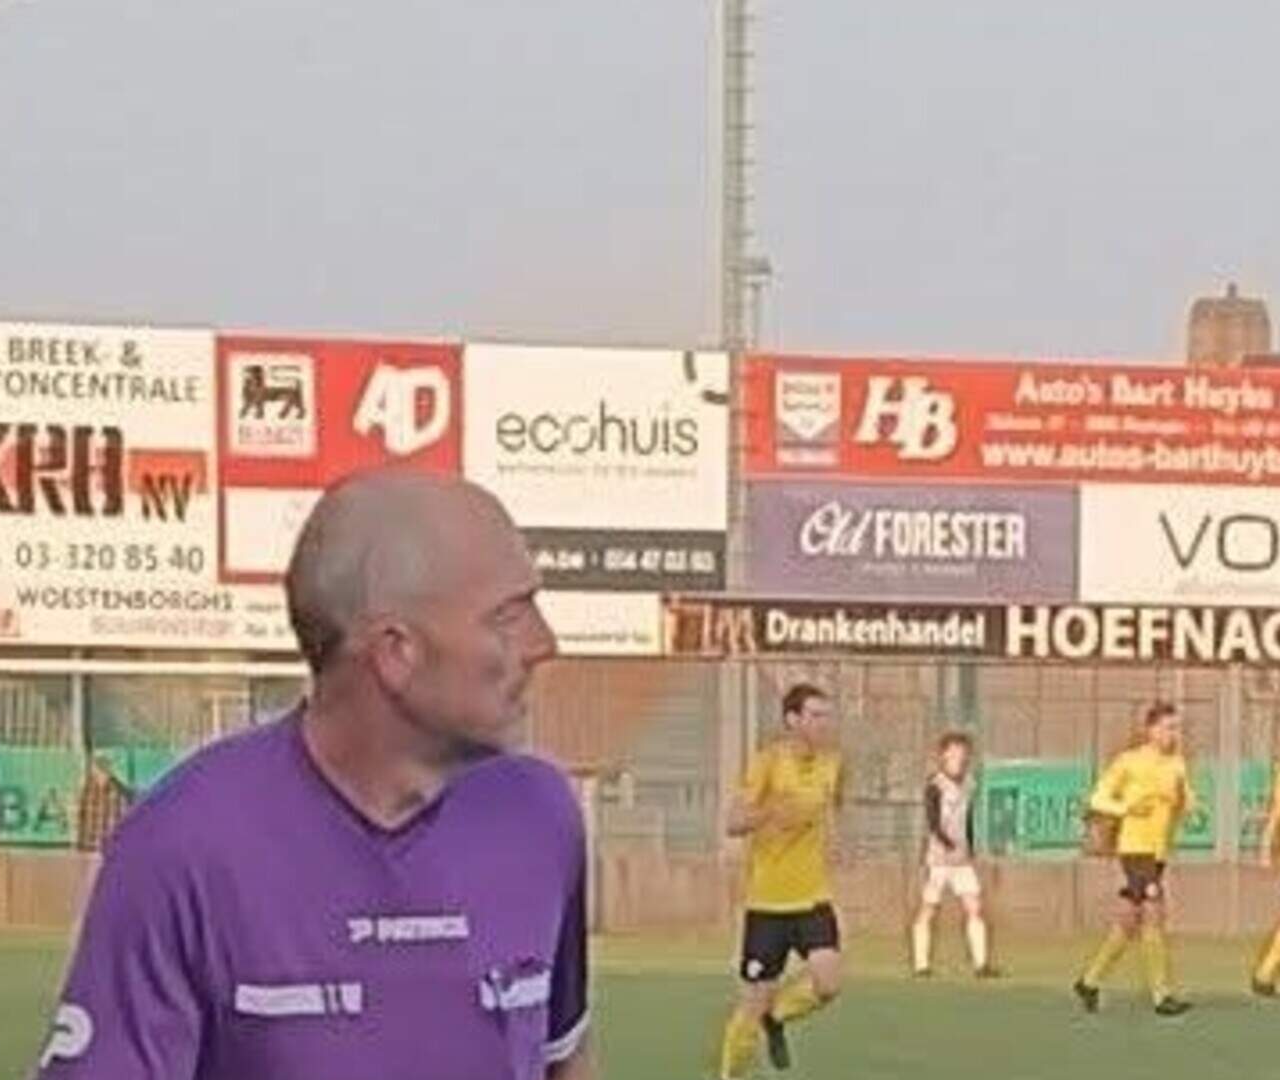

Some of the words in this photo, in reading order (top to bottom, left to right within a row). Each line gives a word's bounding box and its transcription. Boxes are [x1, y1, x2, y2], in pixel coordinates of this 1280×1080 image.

[120, 338, 144, 370] &
[1111, 373, 1173, 407] Bart
[495, 400, 700, 457] ecohuis
[854, 375, 958, 460] HB
[140, 471, 195, 524] NV
[875, 511, 1026, 558] FORESTER
[65, 545, 116, 571] 320
[124, 546, 159, 572] 85
[169, 546, 205, 574] 40
[765, 608, 986, 648] Drankenhandel
